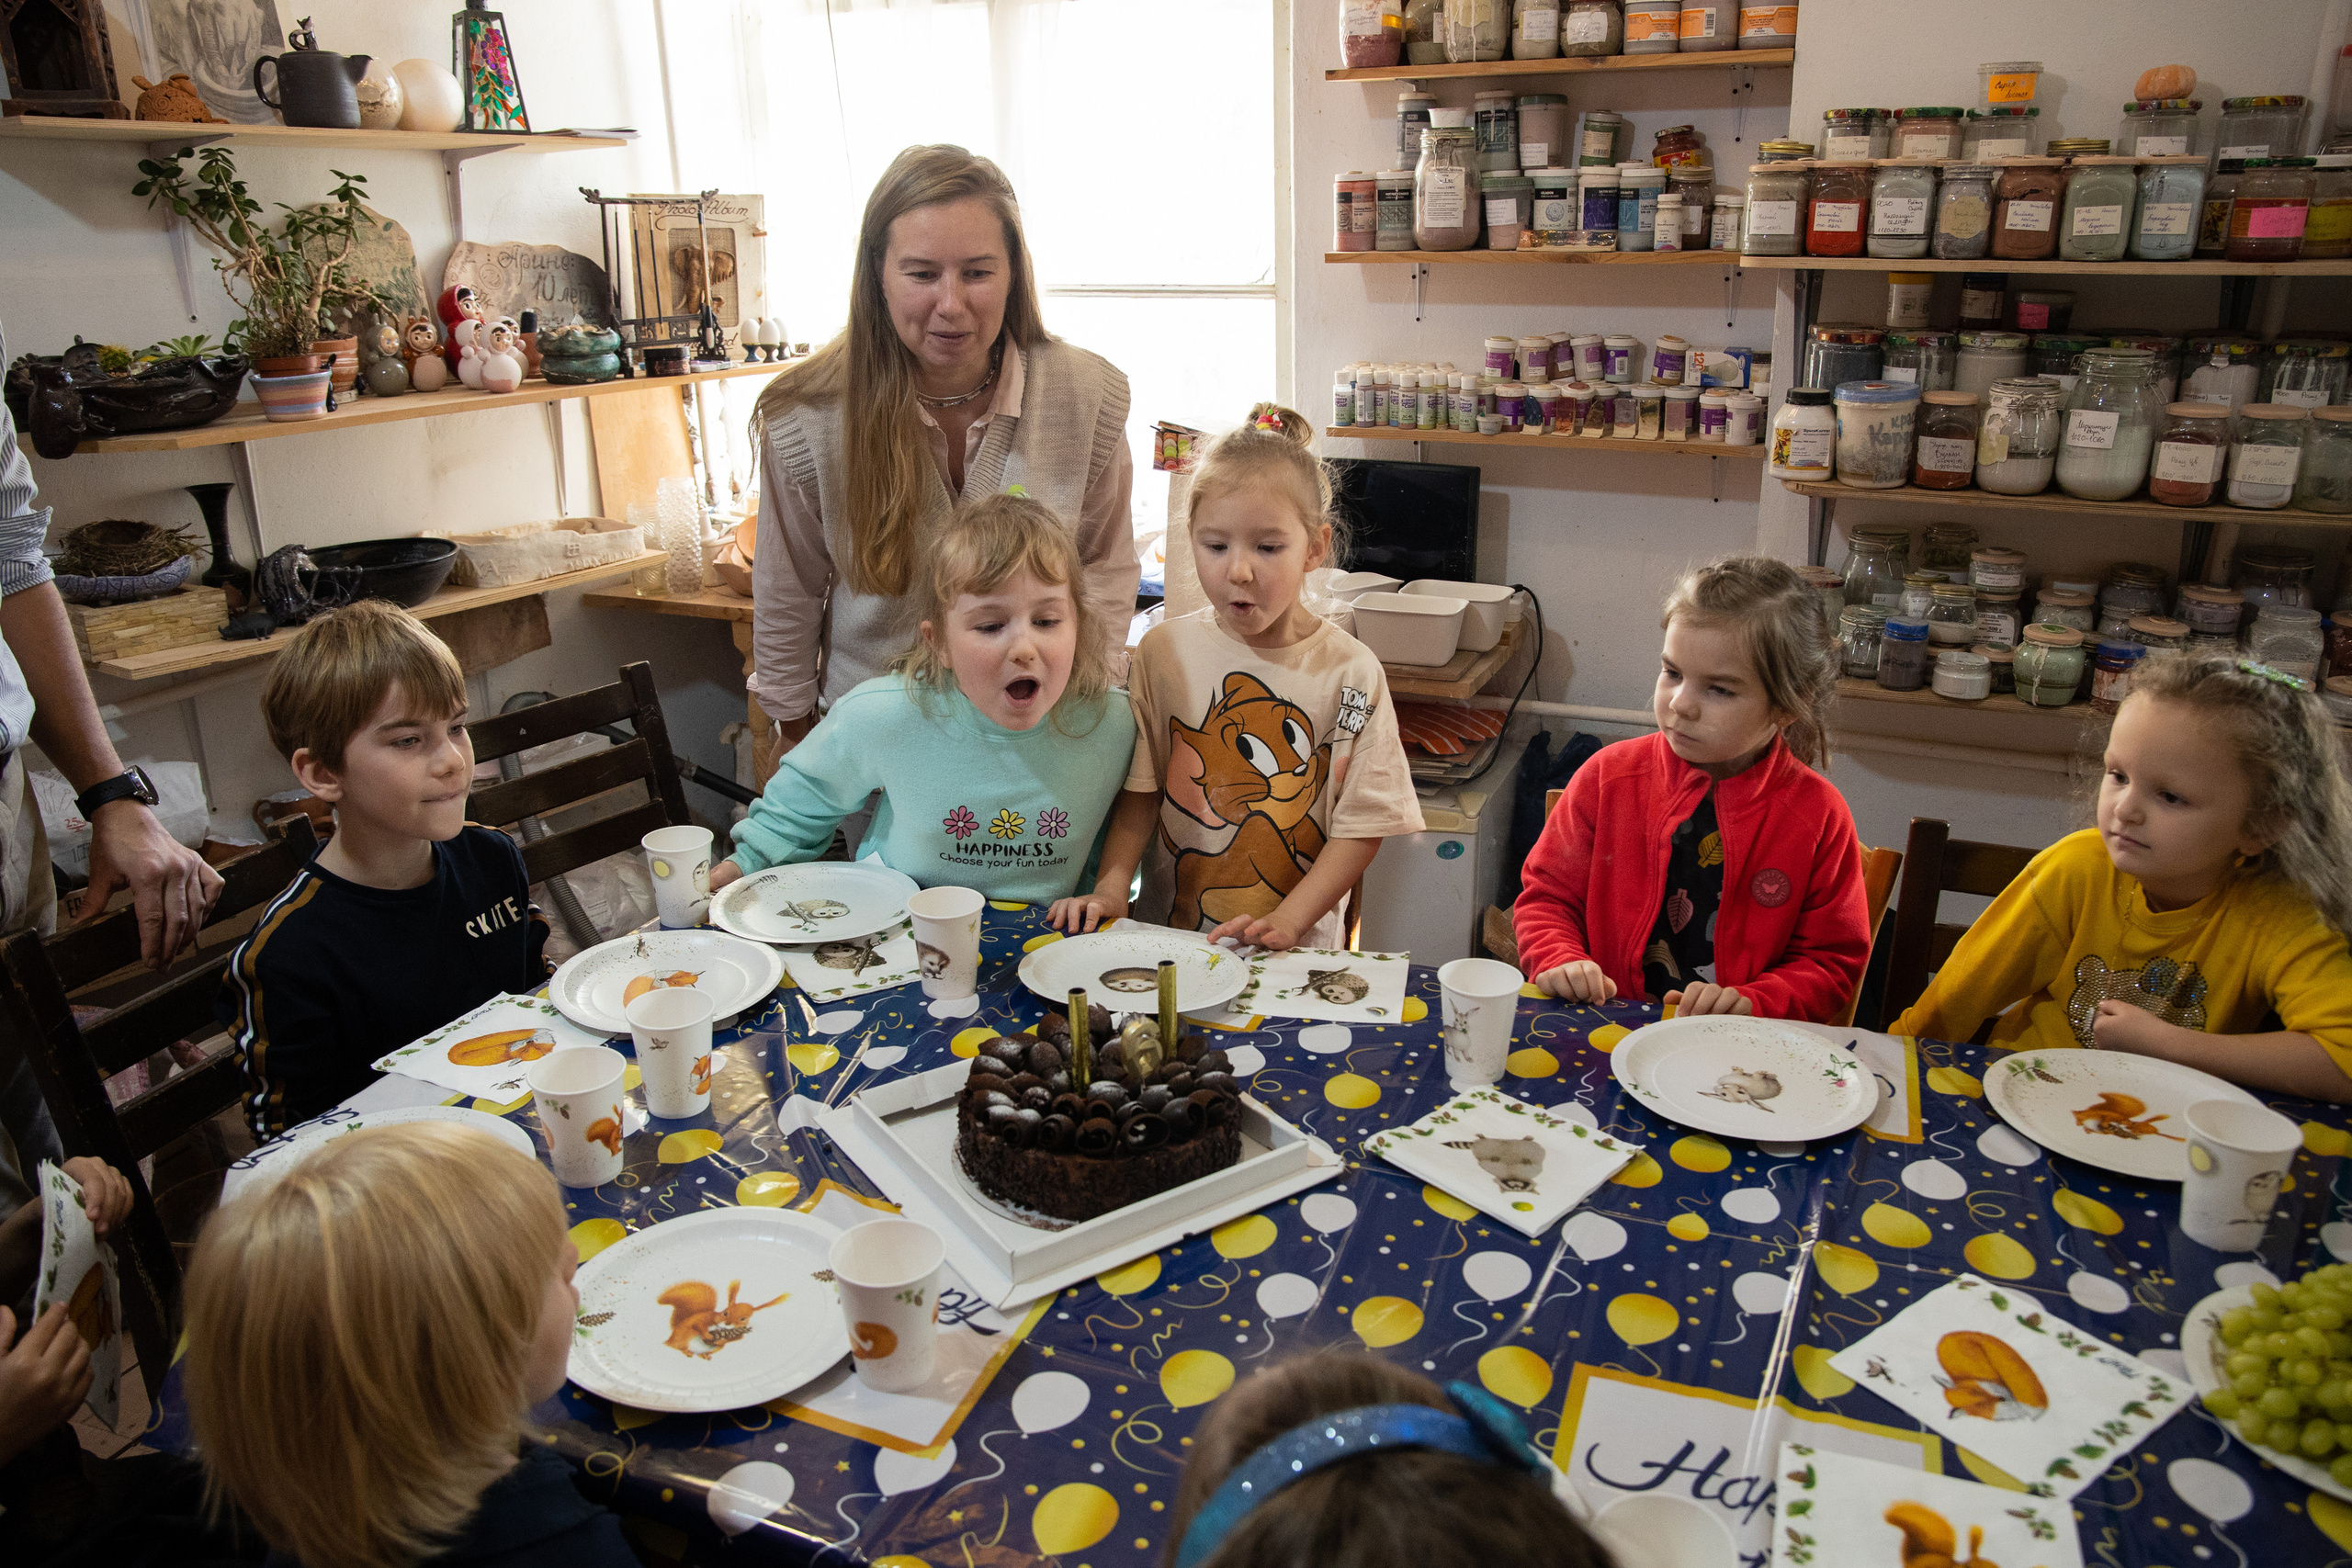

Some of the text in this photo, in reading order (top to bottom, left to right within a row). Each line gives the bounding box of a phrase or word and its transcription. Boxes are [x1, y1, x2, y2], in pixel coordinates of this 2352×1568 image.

[654, 199, 749, 217] Photo Album
[1694, 352, 1705, 371] 120
[1340, 685, 1367, 711] TOM
[956, 841, 1054, 857] HAPPINESS
[939, 852, 1069, 869] Choose your fun today
